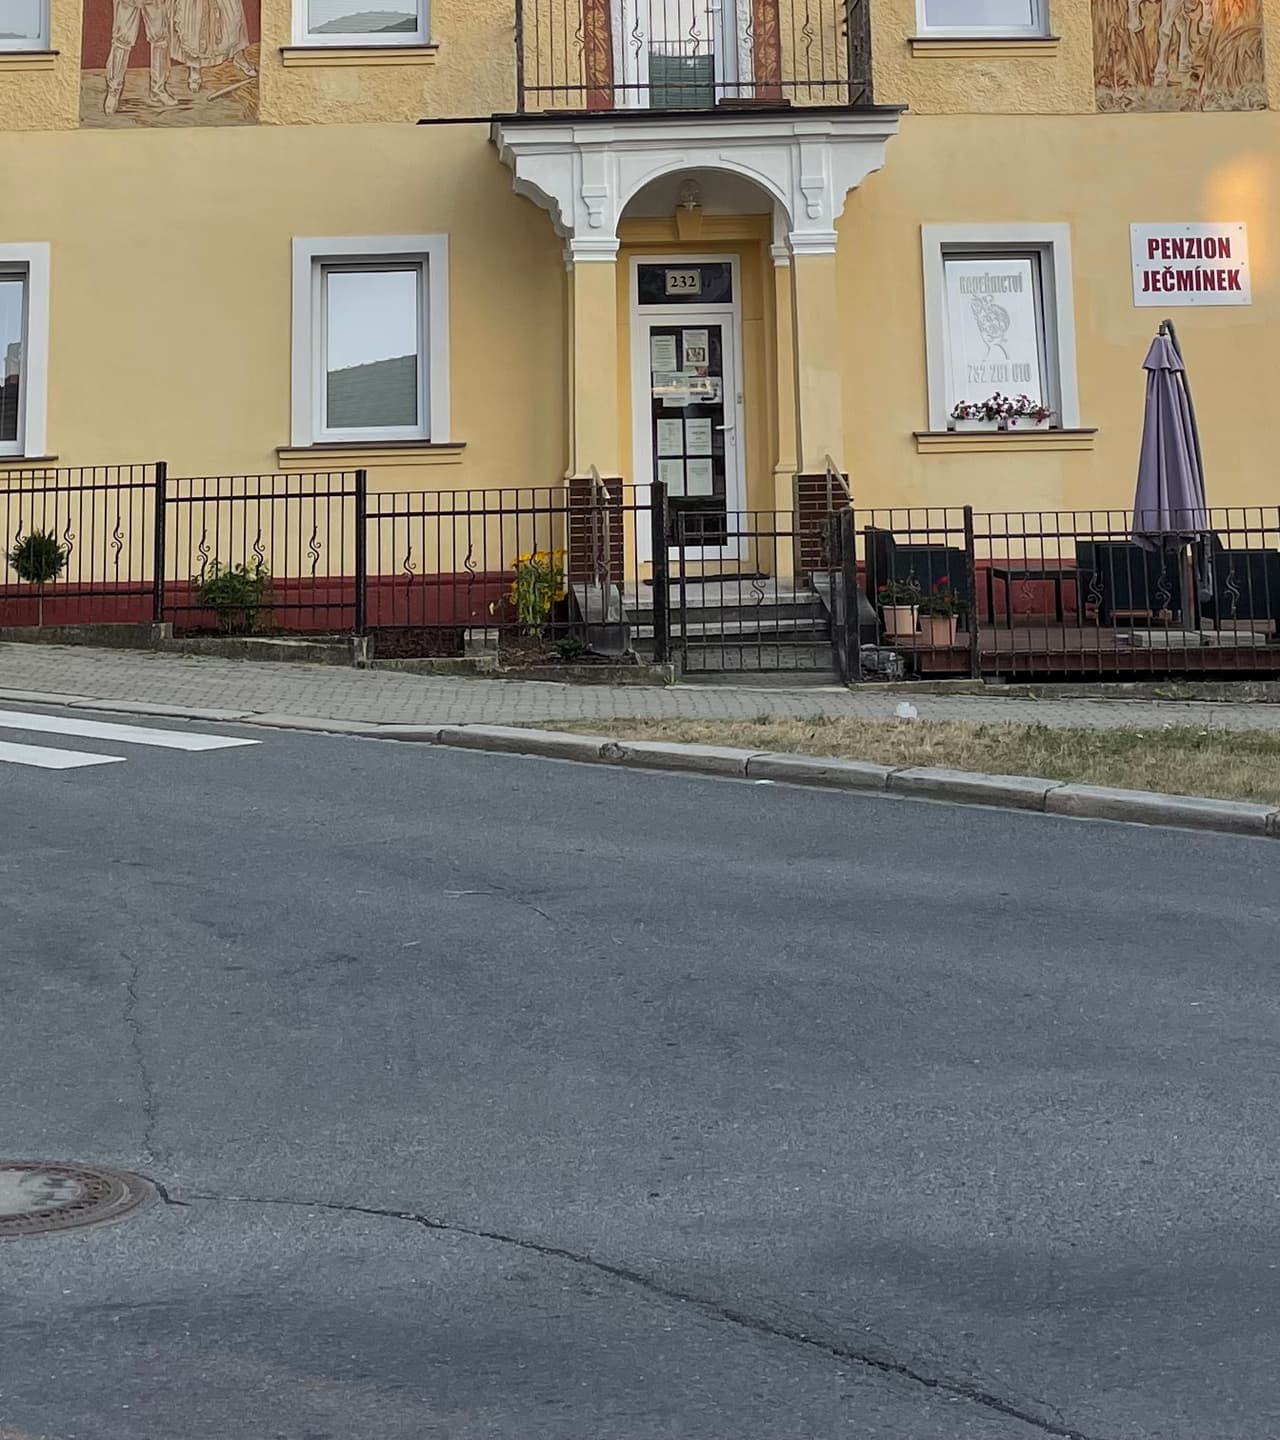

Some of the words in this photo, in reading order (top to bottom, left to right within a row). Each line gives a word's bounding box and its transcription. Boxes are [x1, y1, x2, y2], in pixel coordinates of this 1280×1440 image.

[1147, 237, 1231, 259] PENZION
[670, 275, 696, 288] 232
[1142, 265, 1241, 292] JEČMÍNEK
